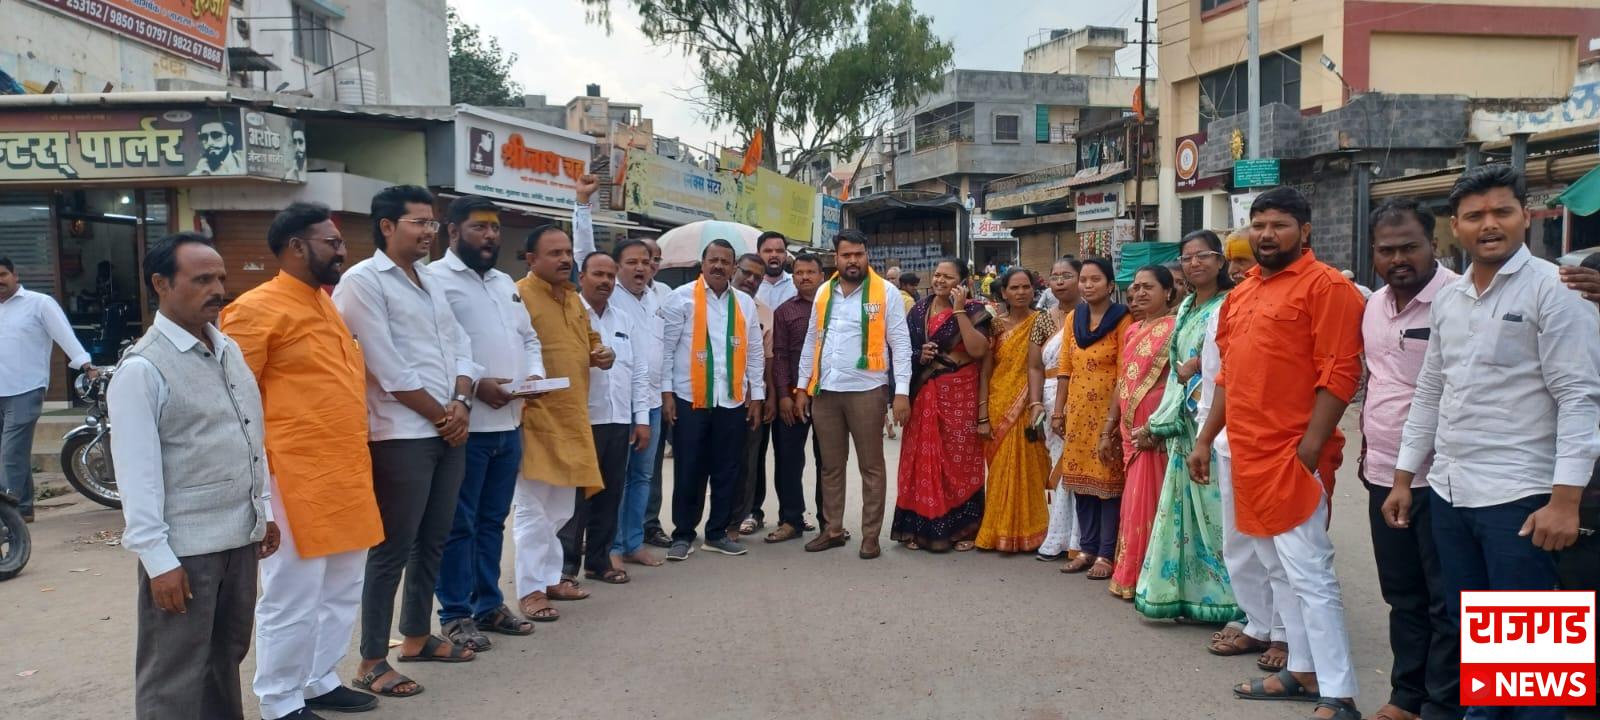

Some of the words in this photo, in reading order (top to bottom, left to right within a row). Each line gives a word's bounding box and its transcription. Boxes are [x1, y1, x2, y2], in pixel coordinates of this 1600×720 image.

[110, 9, 134, 30] 9850
[135, 19, 146, 34] 15
[146, 24, 168, 43] 0797
[172, 34, 192, 52] 9822
[192, 42, 202, 56] 67
[77, 117, 184, 166] पार्लर
[248, 127, 281, 149] अशोक
